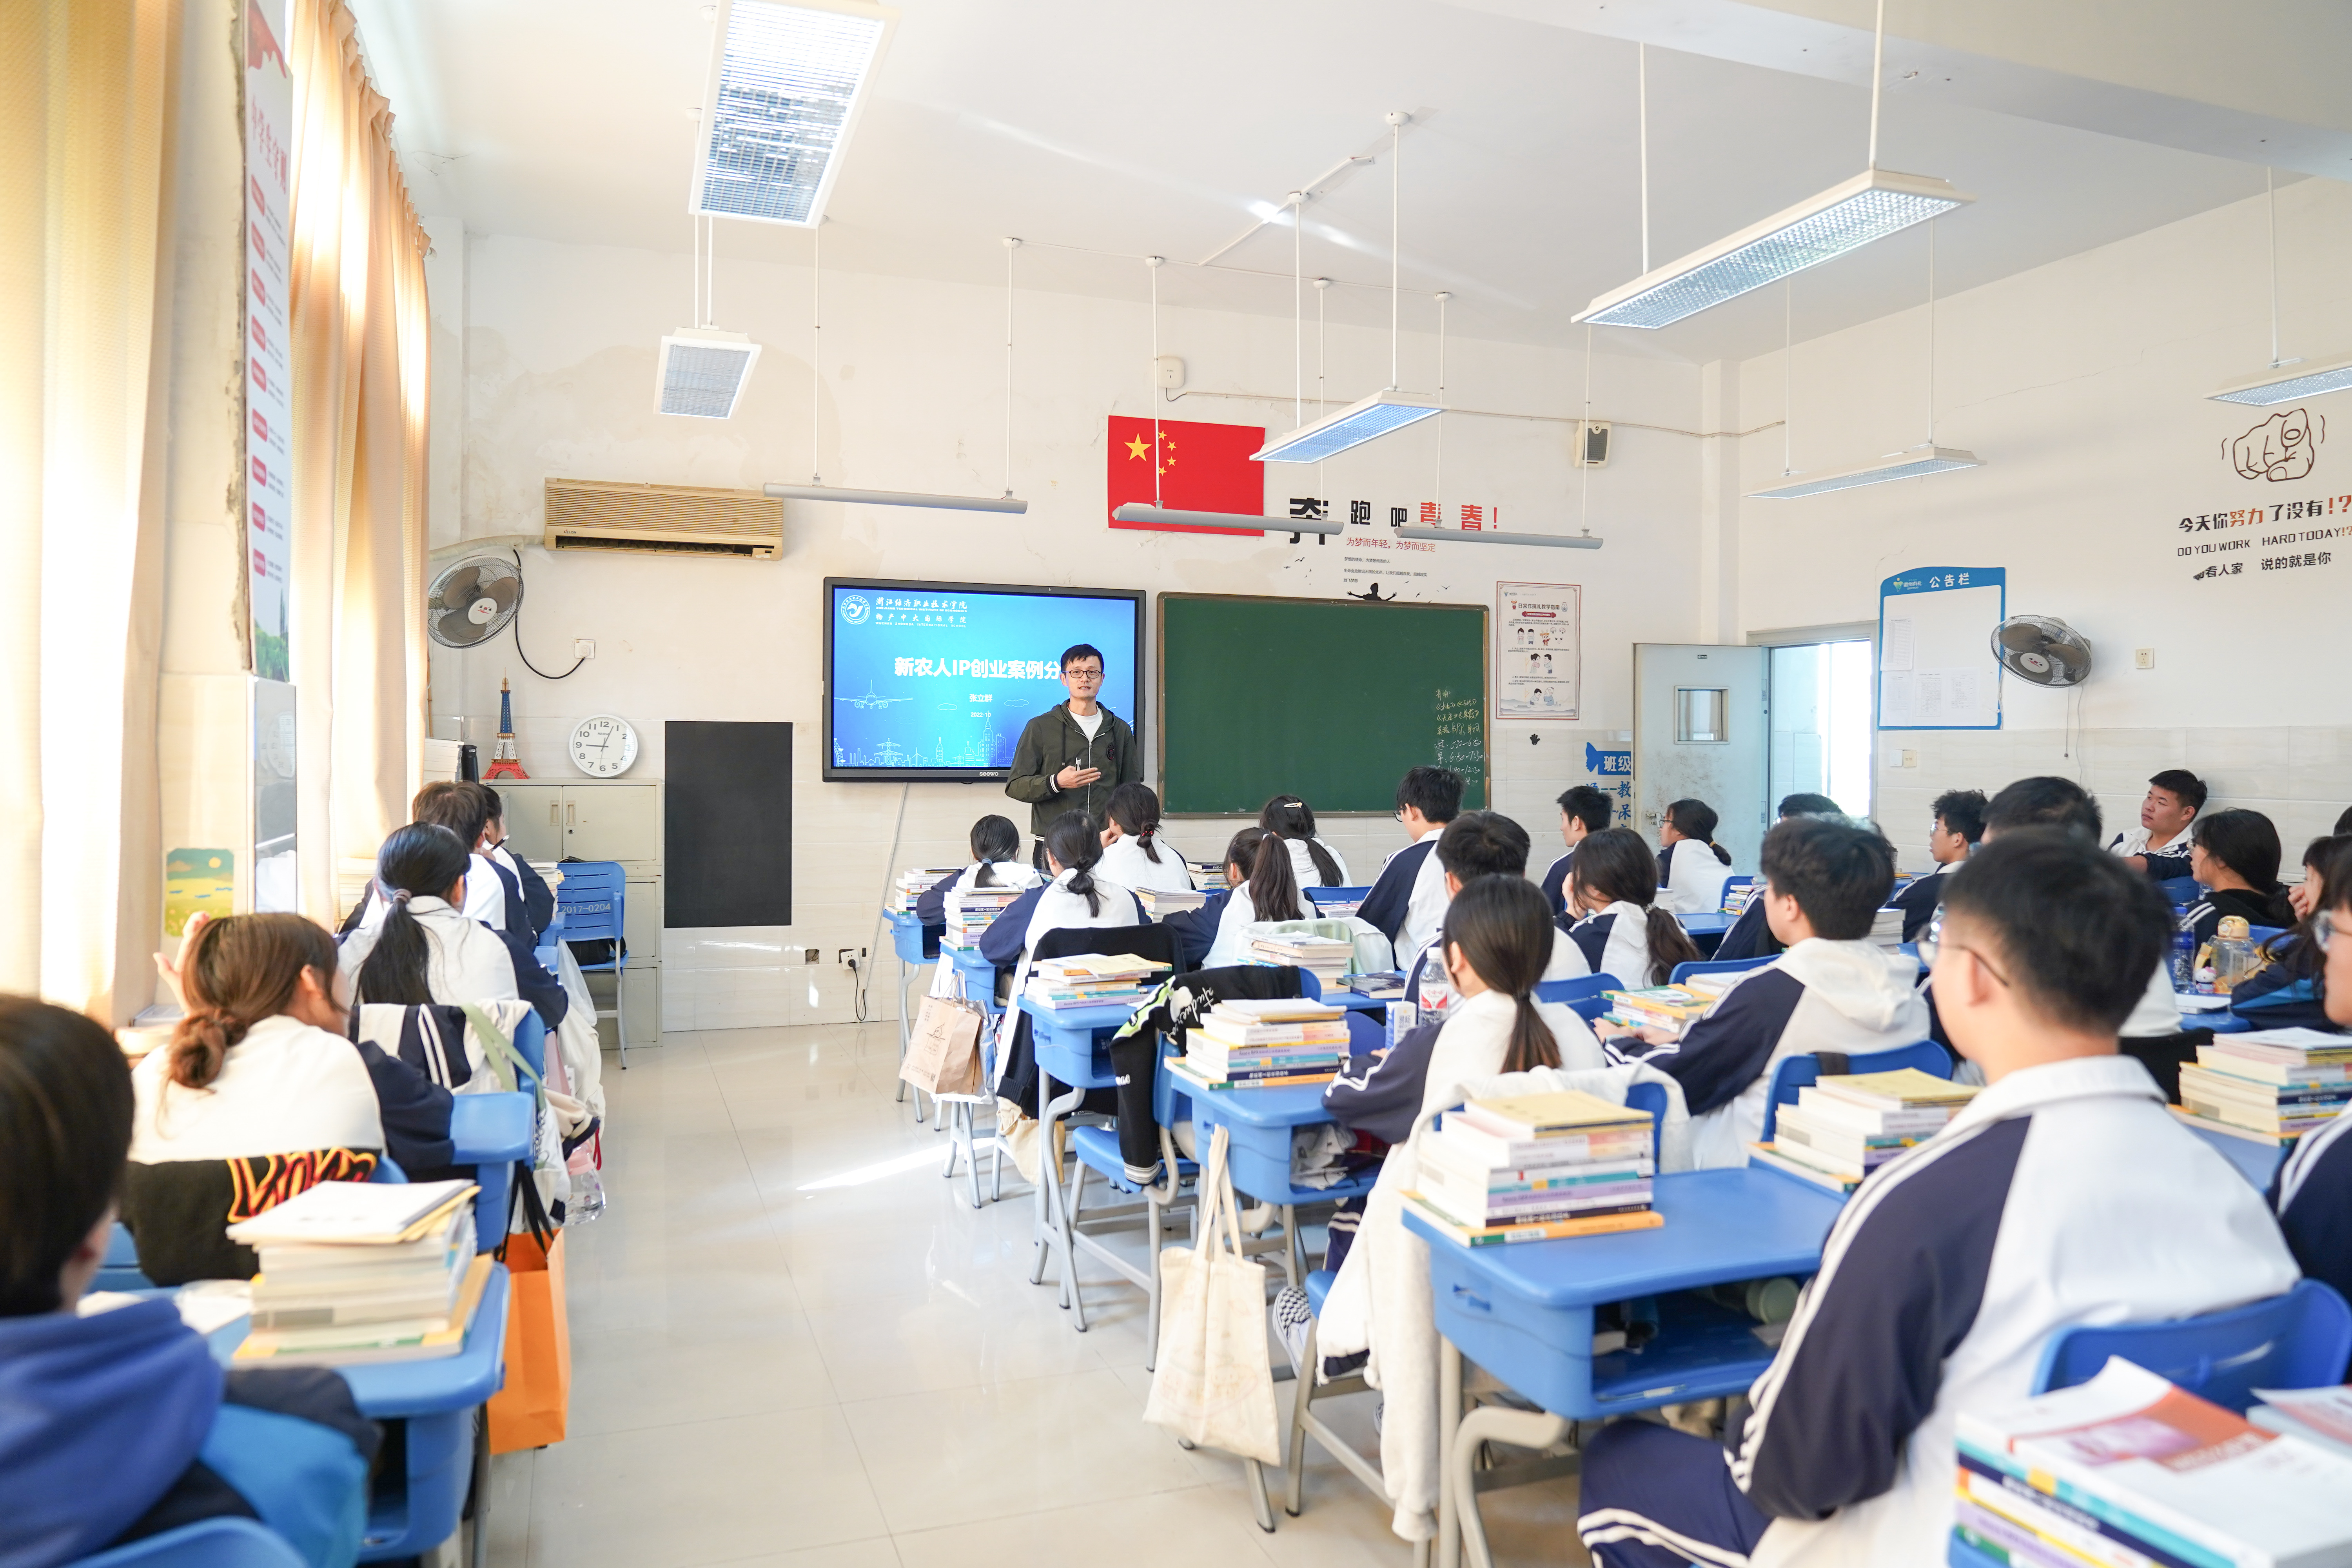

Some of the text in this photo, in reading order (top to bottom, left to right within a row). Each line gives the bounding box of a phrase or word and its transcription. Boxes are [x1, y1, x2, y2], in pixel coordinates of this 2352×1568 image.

[2178, 546, 2191, 556] DO
[2194, 544, 2216, 554] YOU
[2219, 539, 2250, 552] WORK
[2262, 534, 2296, 546] HARD
[2193, 552, 2331, 581] 看人家 说的就是你
[1929, 572, 1970, 588] 公告栏
[876, 597, 967, 609] 浙江经济职业技术学院
[876, 613, 967, 624] 物产中大国际学院
[894, 657, 1061, 679] 新农人IP创业案例分
[969, 693, 993, 702] 张立群
[1603, 755, 1631, 772] 班级
[561, 903, 611, 914] 2017-0204
